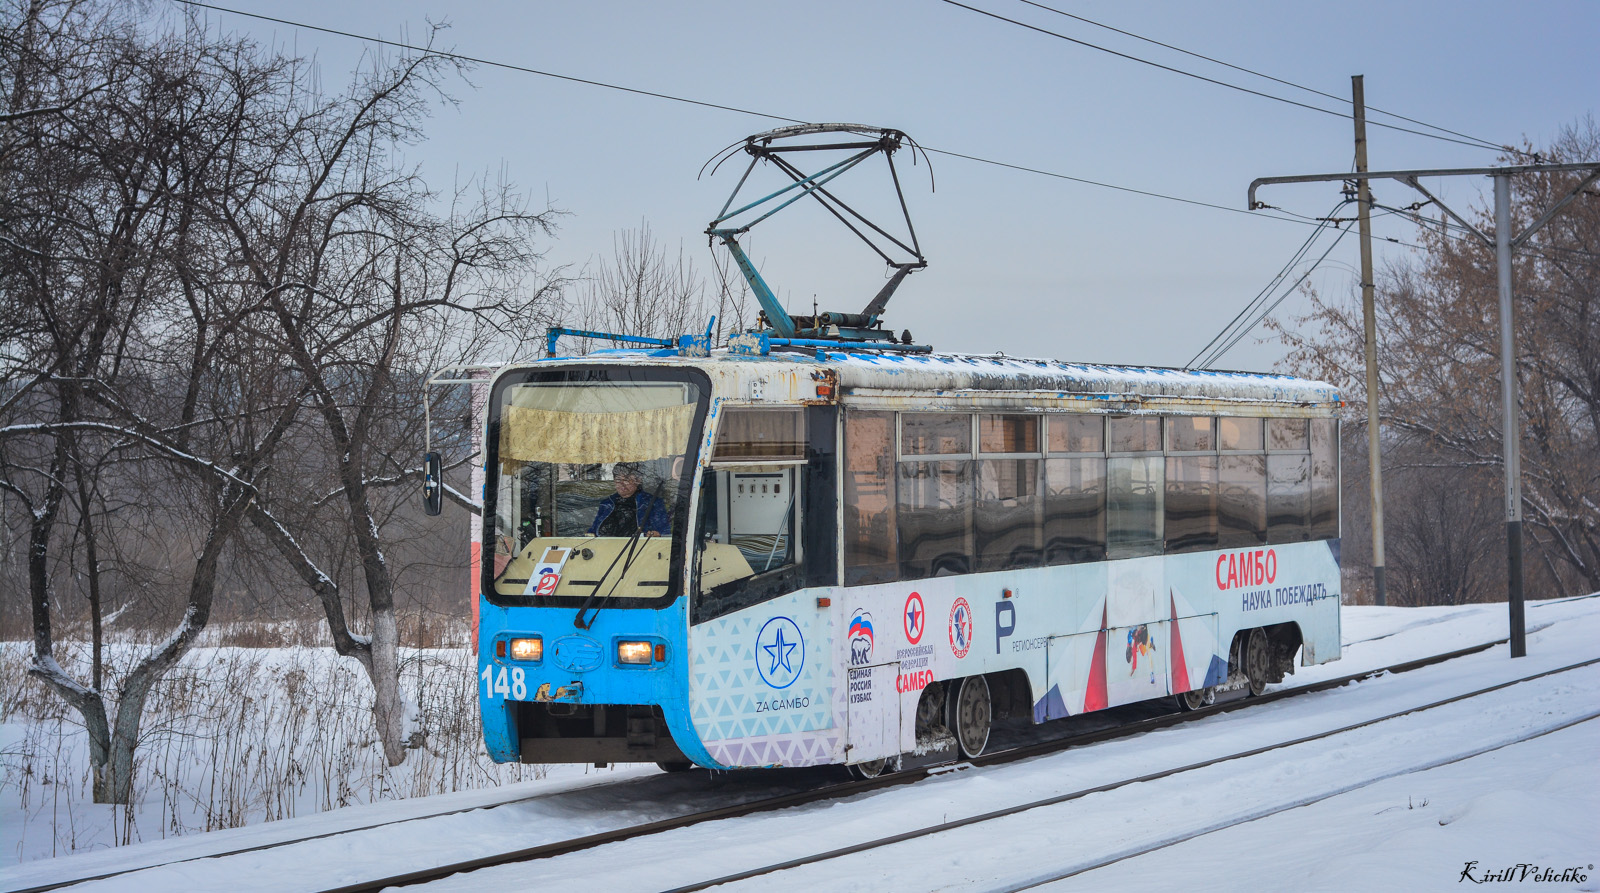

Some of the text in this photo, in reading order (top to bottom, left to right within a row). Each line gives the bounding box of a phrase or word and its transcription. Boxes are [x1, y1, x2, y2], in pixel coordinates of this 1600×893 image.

[1215, 548, 1277, 590] САМБО
[538, 576, 556, 594] 2
[1242, 583, 1327, 611] НАУКА ПОБЕЖДАТЬ
[481, 664, 527, 700] 148
[850, 669, 872, 680] ЕДИНАЯ
[896, 669, 934, 694] САМБО
[850, 680, 872, 692] РОССИЯ
[772, 697, 809, 711] САМБО
[850, 692, 872, 704] КУЗБАСС
